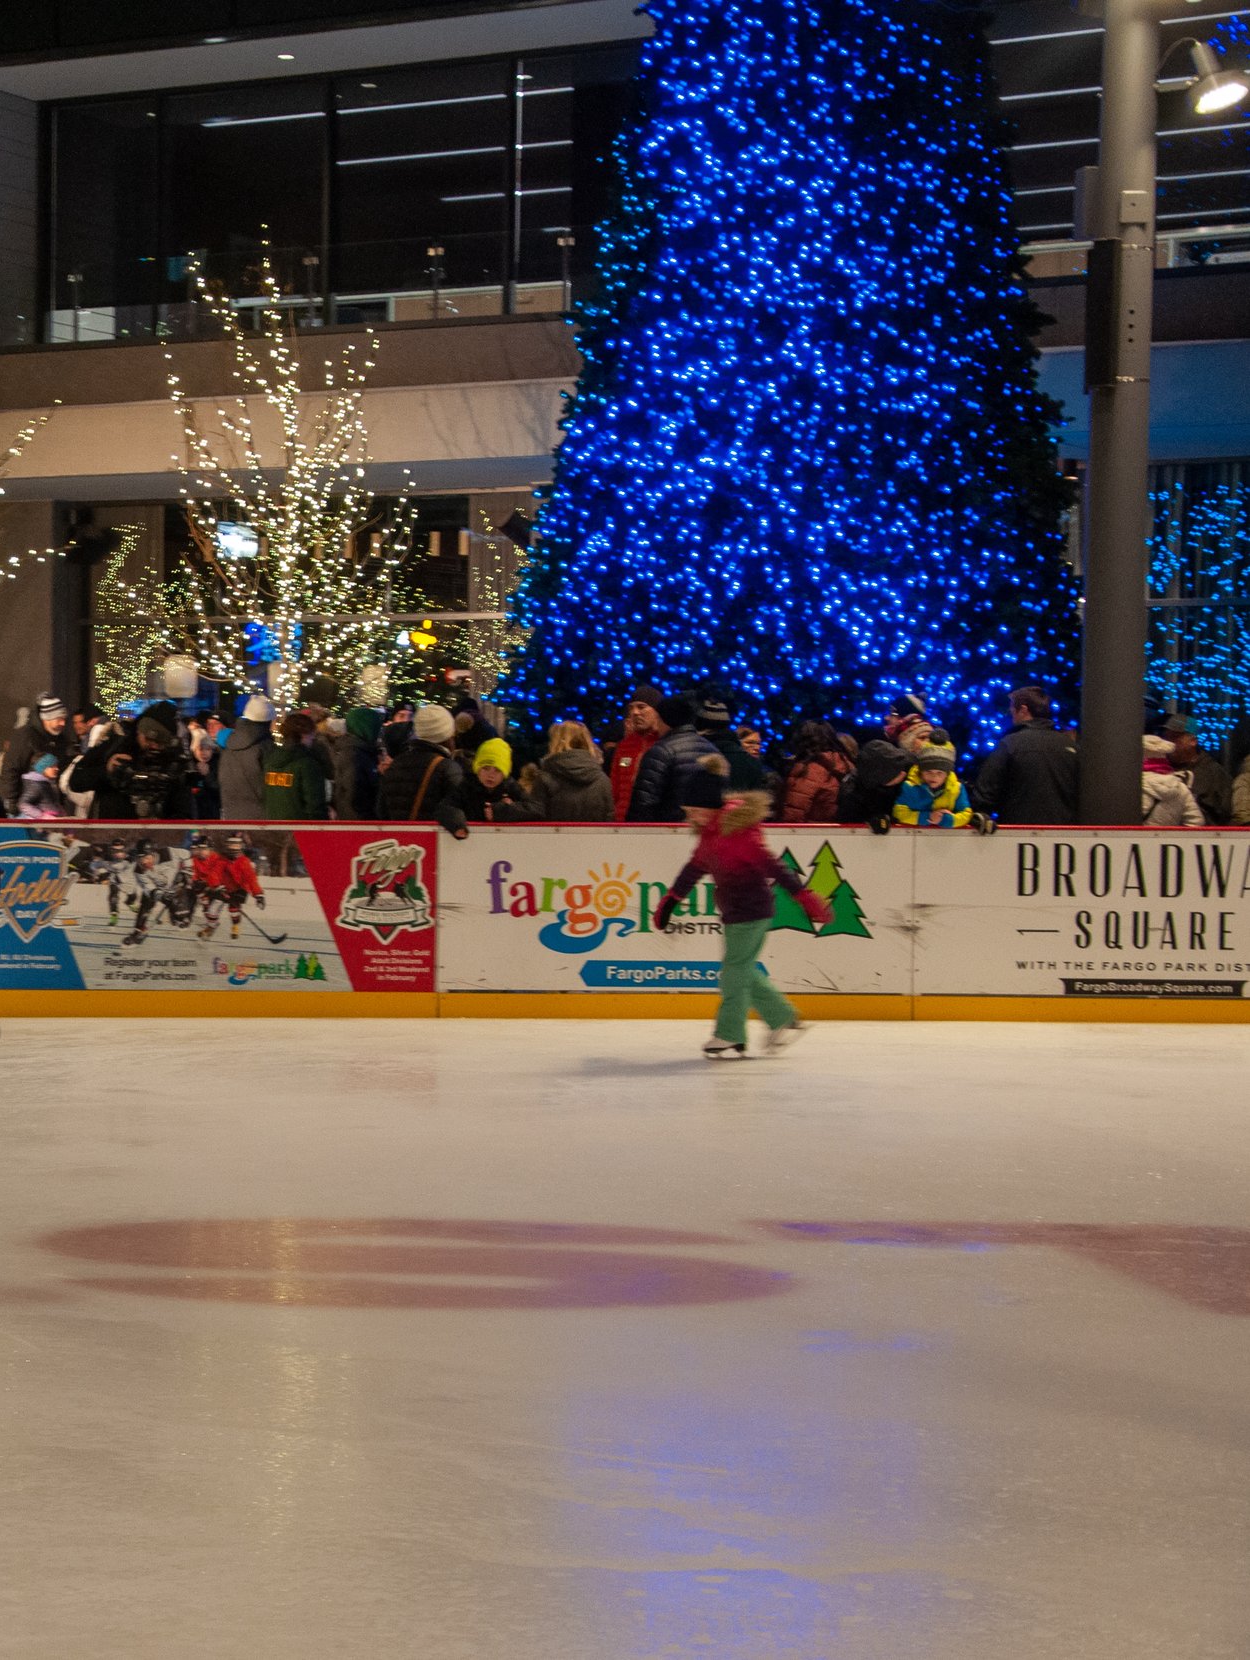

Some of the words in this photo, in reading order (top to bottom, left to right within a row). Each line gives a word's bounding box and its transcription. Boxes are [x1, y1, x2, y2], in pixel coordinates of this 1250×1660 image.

[1017, 843, 1250, 898] BROADW
[486, 860, 634, 936] fargo
[636, 881, 721, 933] par
[664, 922, 722, 935] DISTR
[1075, 910, 1235, 950] SQUARE
[606, 966, 722, 980] FargoParks.co
[1016, 960, 1057, 971] WITH
[1063, 961, 1095, 971] THE
[1102, 962, 1157, 972] FARGO
[1164, 963, 1208, 973] PARK
[1074, 981, 1234, 994] FargoBroadwaySquare.com
